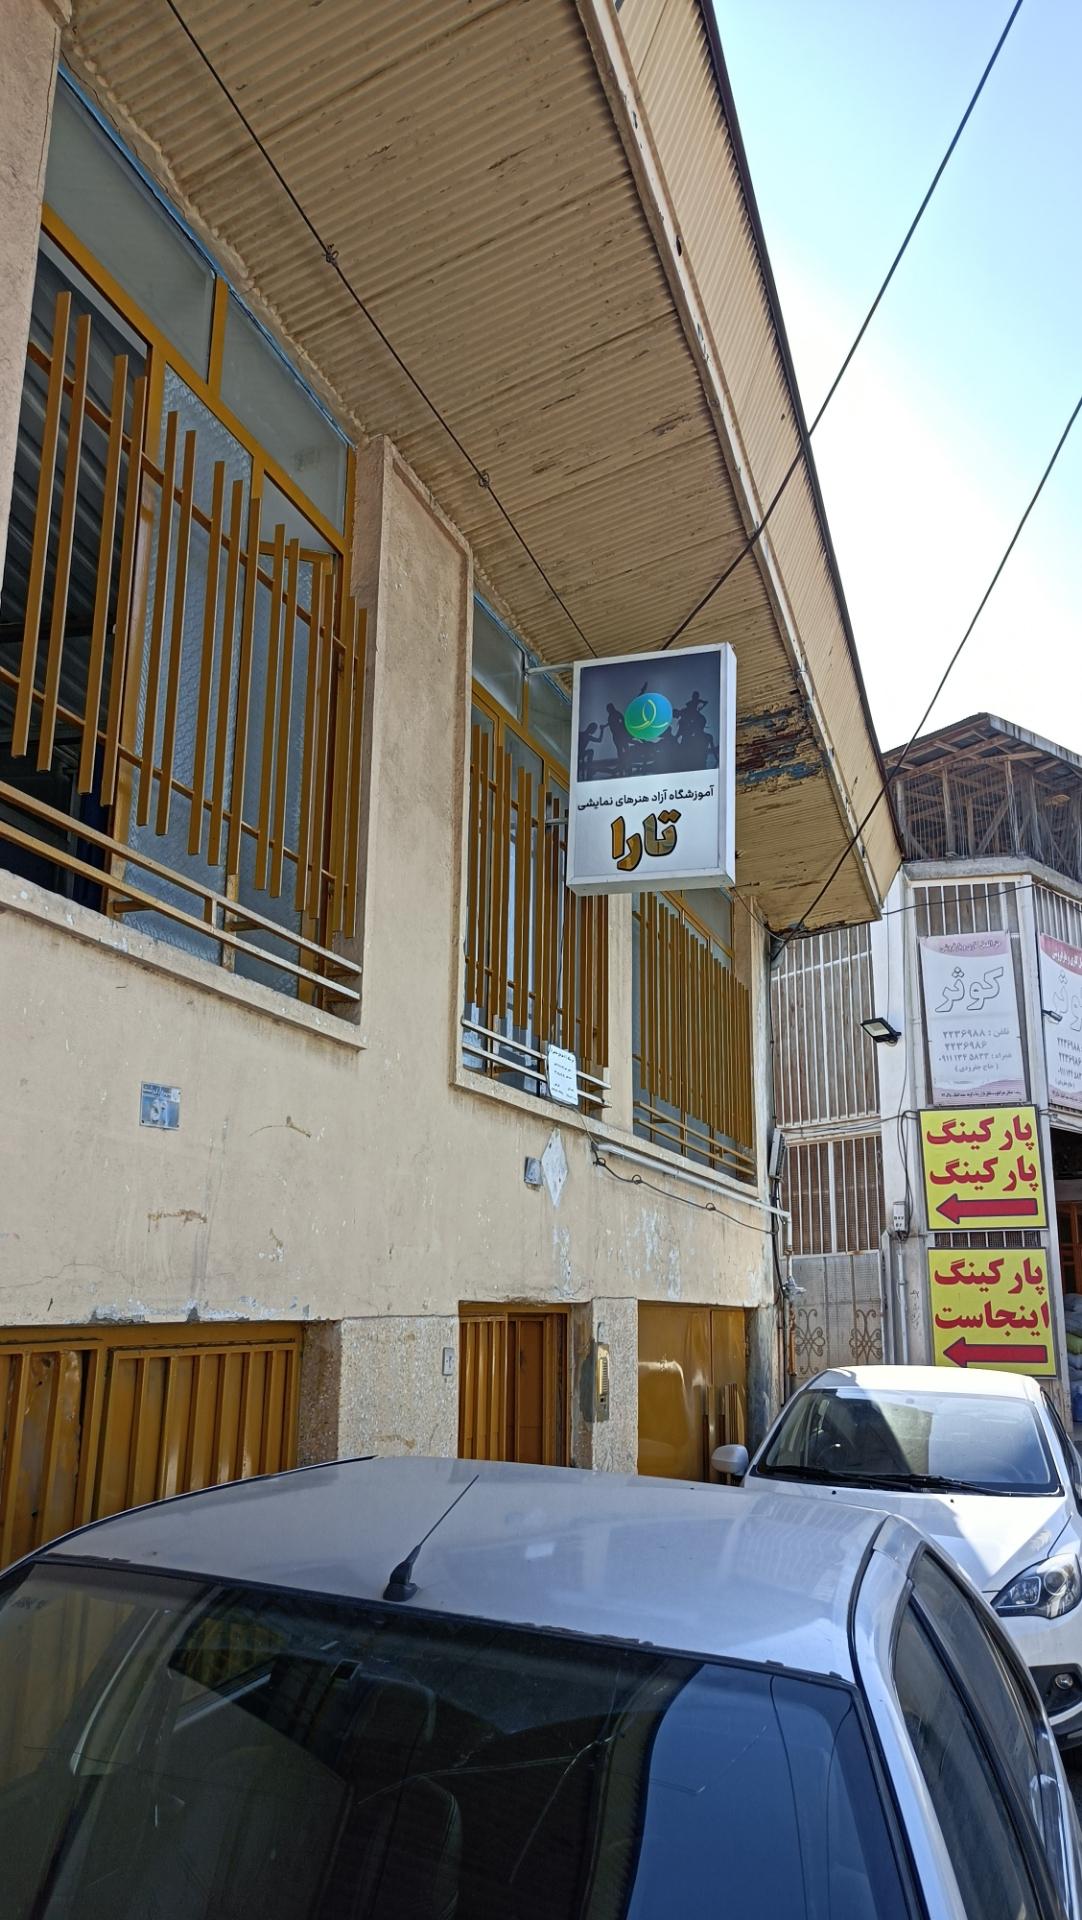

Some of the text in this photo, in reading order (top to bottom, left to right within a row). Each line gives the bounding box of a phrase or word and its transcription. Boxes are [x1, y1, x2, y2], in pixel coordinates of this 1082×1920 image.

[577, 784, 714, 811] آموزشگاه آزاد هنرهای نمایشی
[611, 809, 681, 872] تارا
[934, 966, 1004, 1013] کوثر
[926, 1114, 1035, 1151] پارکینگ
[929, 1155, 1039, 1192] پارکینگ
[934, 1257, 1046, 1295] پارکینگ
[934, 1300, 1050, 1337] اینجاست
